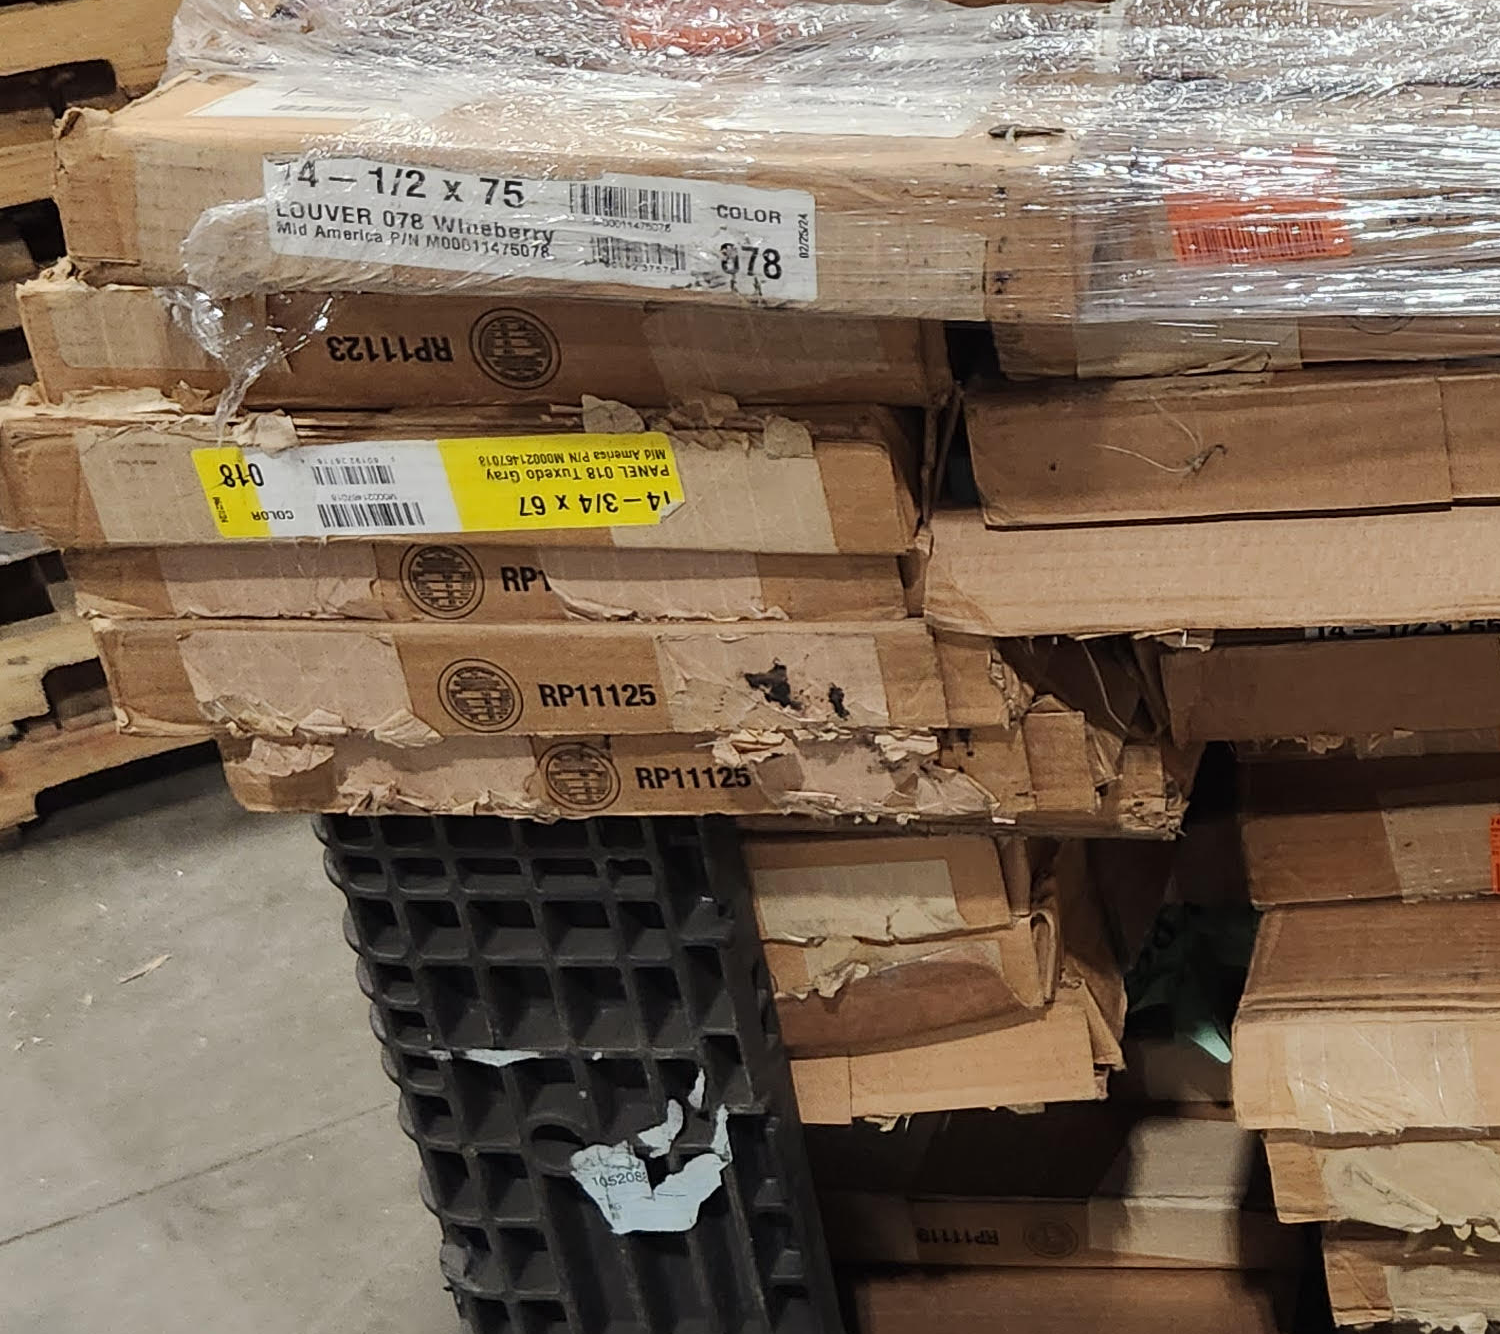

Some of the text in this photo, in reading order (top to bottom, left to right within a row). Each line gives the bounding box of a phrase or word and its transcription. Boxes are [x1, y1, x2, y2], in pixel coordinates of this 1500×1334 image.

[369, 167, 426, 199] 1/2
[442, 179, 463, 203] x
[479, 177, 525, 208] 75
[276, 201, 554, 244] LOUVER 078 Wineberry
[717, 205, 781, 224] COLOR
[277, 221, 307, 236] Mid
[315, 227, 383, 244] America
[390, 233, 419, 248] P/N
[720, 243, 782, 280] 078
[326, 336, 454, 362] RP11123
[570, 452, 590, 464] P/N
[594, 449, 640, 462] America
[645, 448, 667, 460] Mid
[219, 462, 264, 488] 018
[487, 465, 670, 483] PANEL 018 Tuxedo Gray
[520, 496, 546, 516] 67
[555, 494, 570, 511] x
[580, 493, 619, 514] 3/4
[252, 509, 294, 521] COLOR
[537, 684, 657, 708] RP11125
[635, 767, 751, 790] RP11125
